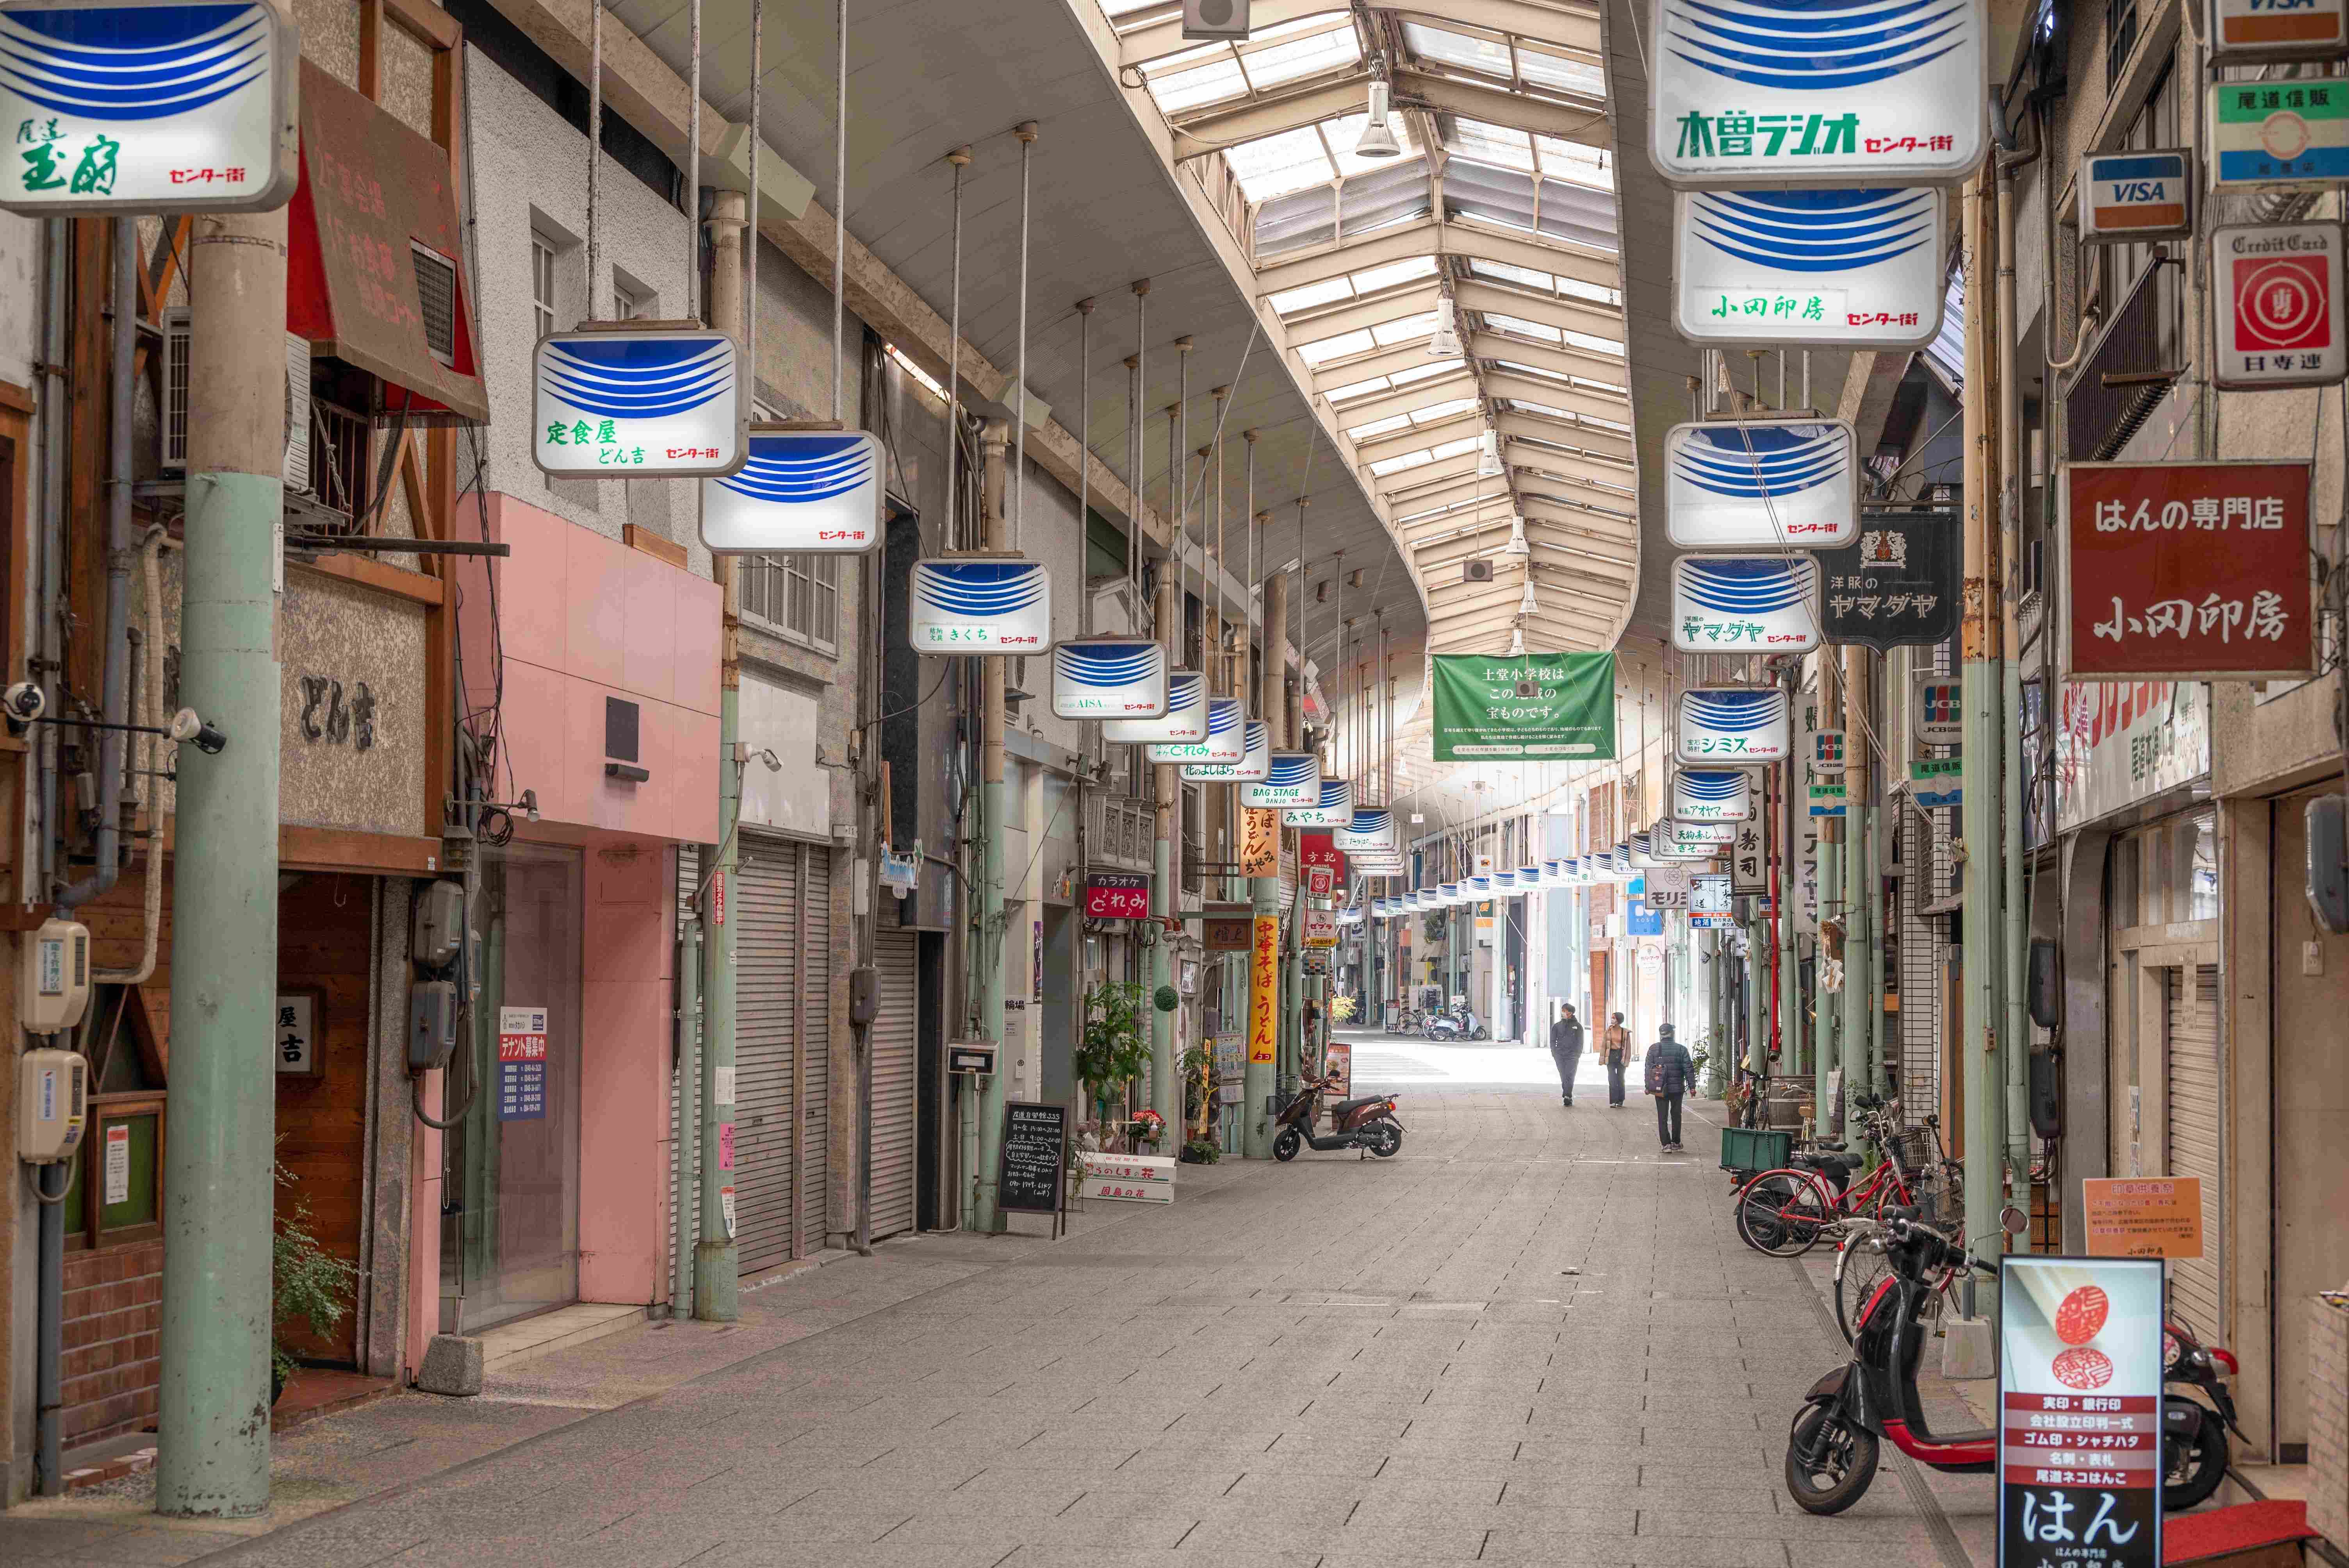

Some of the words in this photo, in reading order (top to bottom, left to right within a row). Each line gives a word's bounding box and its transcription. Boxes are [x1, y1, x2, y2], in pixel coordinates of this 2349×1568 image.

[2238, 89, 2329, 110] 尾道信販
[16, 118, 68, 143] 尾道
[1677, 110, 1860, 158] 木曽ラジオ
[1865, 135, 1953, 153] センター街
[169, 168, 246, 184] センター街
[2113, 182, 2165, 202] VISA
[2232, 236, 2287, 253] Credit
[2287, 233, 2327, 252] Card
[1712, 295, 1825, 321] 小田印房
[1847, 313, 1918, 326] センター街
[2244, 353, 2321, 372] 日専連
[546, 420, 618, 445] 定食屋
[599, 448, 646, 465] どん吉
[667, 448, 719, 459] センター街
[2096, 497, 2284, 531] はんの専門店
[819, 531, 865, 540] センター街
[1788, 524, 1838, 534] センター街
[1830, 576, 1878, 589] 洋服の
[1830, 593, 1937, 620] ヤマダヤ
[2093, 591, 2290, 644] 小田印房
[949, 628, 988, 641] きくち
[1682, 620, 1765, 643] ヤマダヤ
[1482, 668, 1565, 681] 土堂小学校は
[1077, 699, 1103, 708] AISA
[1925, 700, 1961, 708] JCB
[1486, 706, 1560, 719] 宝ものです。
[1171, 745, 1209, 756] どれみ
[1702, 737, 1748, 754] シミズ
[1921, 762, 1962, 773] 尾道信販
[1286, 812, 1324, 823] みやち
[1690, 805, 1721, 817] アオヤマ
[1098, 876, 1139, 887] カラオケ
[1091, 893, 1145, 912] どれみ
[1256, 921, 1274, 988] 中華そば
[1005, 1000, 1025, 1010] 輪場
[278, 1006, 296, 1028] 屋
[1255, 995, 1272, 1045] うどん
[280, 1035, 304, 1063] 吉
[502, 1036, 545, 1058] テナント募集中
[1101, 1186, 1145, 1198] 因島の花
[2043, 1396, 2122, 1411] 実印・銀行印
[2030, 1414, 2134, 1431] 会社設立印判一式
[2024, 1433, 2139, 1449] ゴム印・シャチハタ
[2049, 1452, 2115, 1467] 名刺・表札
[2036, 1470, 2126, 1485] 尾道ネコはんこ
[2022, 1490, 2139, 1545] はん
[2055, 1547, 2107, 1559] はんの専門店
